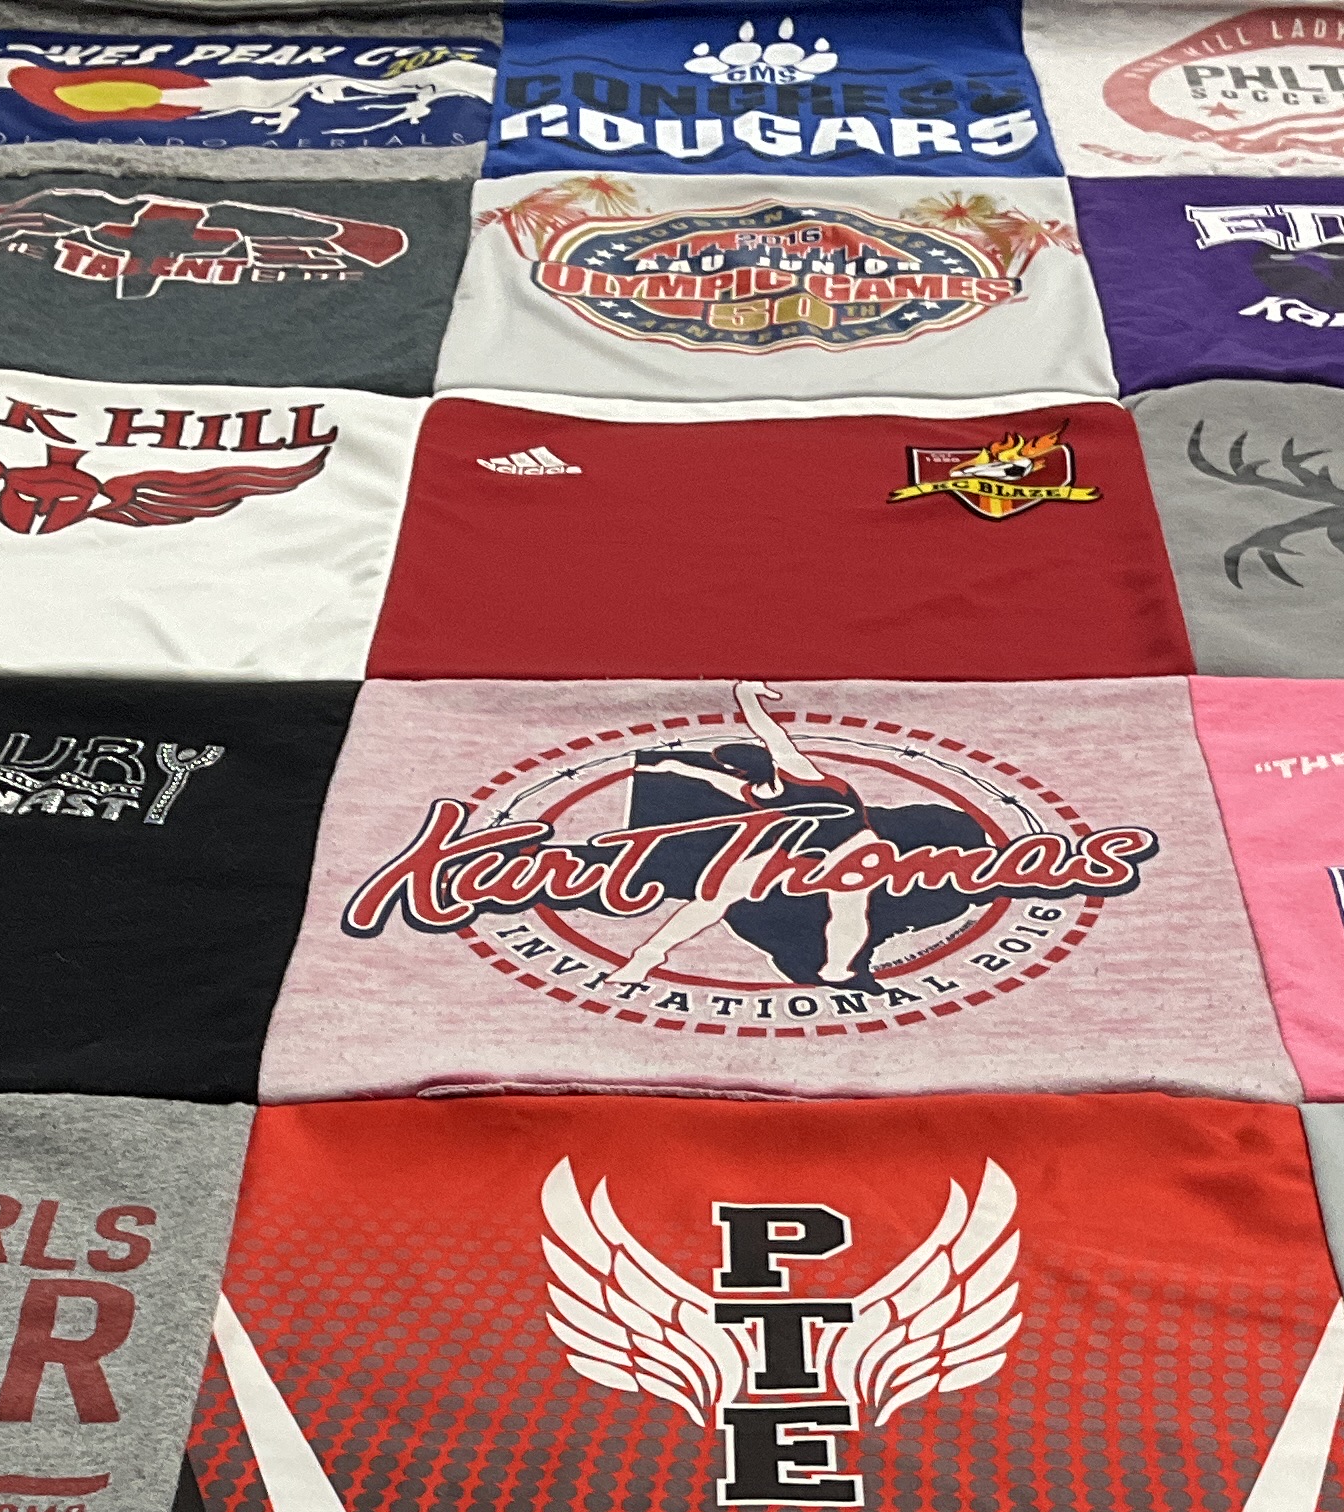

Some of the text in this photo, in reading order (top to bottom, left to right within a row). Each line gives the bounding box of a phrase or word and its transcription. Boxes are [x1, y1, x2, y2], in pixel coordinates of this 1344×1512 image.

[175, 44, 346, 66] PEAK
[500, 104, 1039, 158] COUGARS
[735, 226, 823, 248] 2016
[538, 261, 1016, 303] OLYMPIC GAMES
[635, 254, 725, 274] AAU
[99, 404, 338, 451] HILL
[978, 481, 1062, 498] BLAZE
[343, 799, 1158, 937] Kurt Thomas
[495, 904, 1064, 1019] INVITATIONAL 2016
